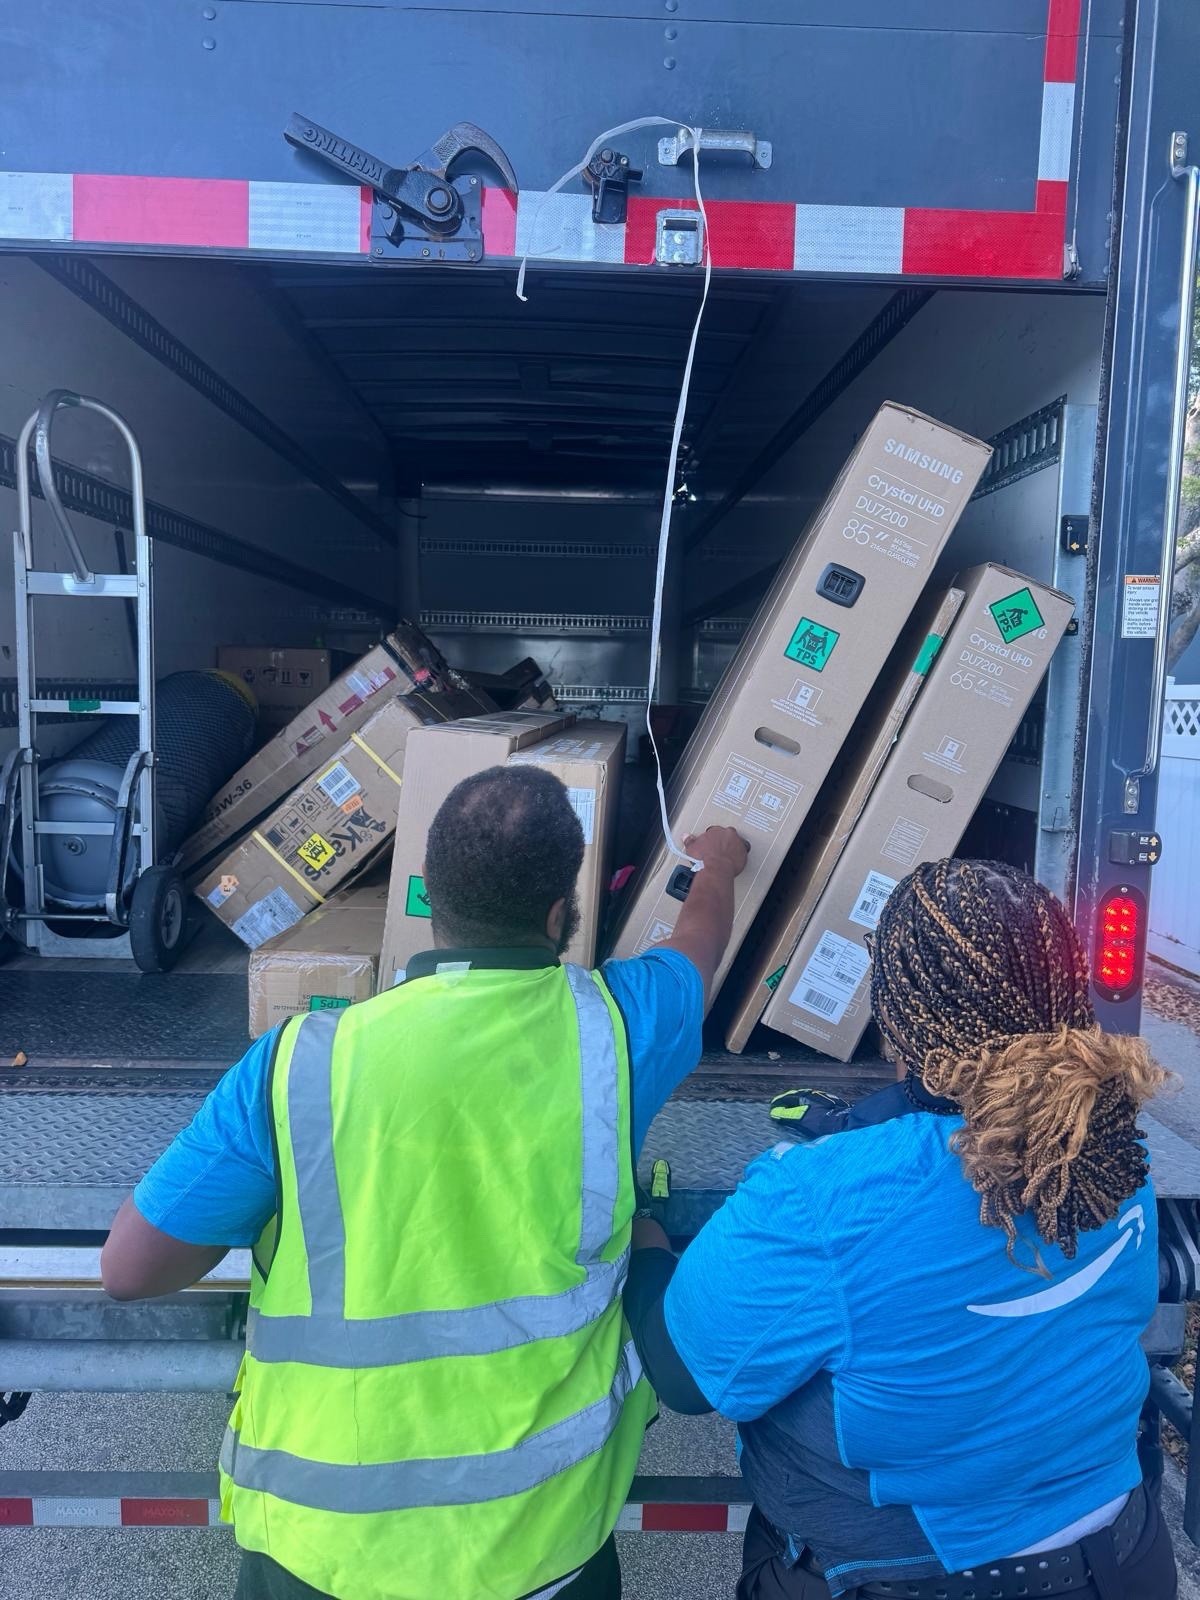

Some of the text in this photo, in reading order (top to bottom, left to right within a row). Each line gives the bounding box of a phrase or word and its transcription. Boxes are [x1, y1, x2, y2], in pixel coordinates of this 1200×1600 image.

[303, 126, 382, 182] WHITING
[884, 438, 965, 485] SAMSUNG
[867, 474, 945, 518] Crystal UHD
[855, 495, 909, 529] DU7200
[997, 611, 1013, 633] TPS
[796, 648, 818, 665] TPS
[960, 650, 1003, 676] DU7200
[969, 633, 1033, 668] Crystal UHD
[301, 838, 318, 852] TPS
[56, 1507, 98, 1517] MAXON
